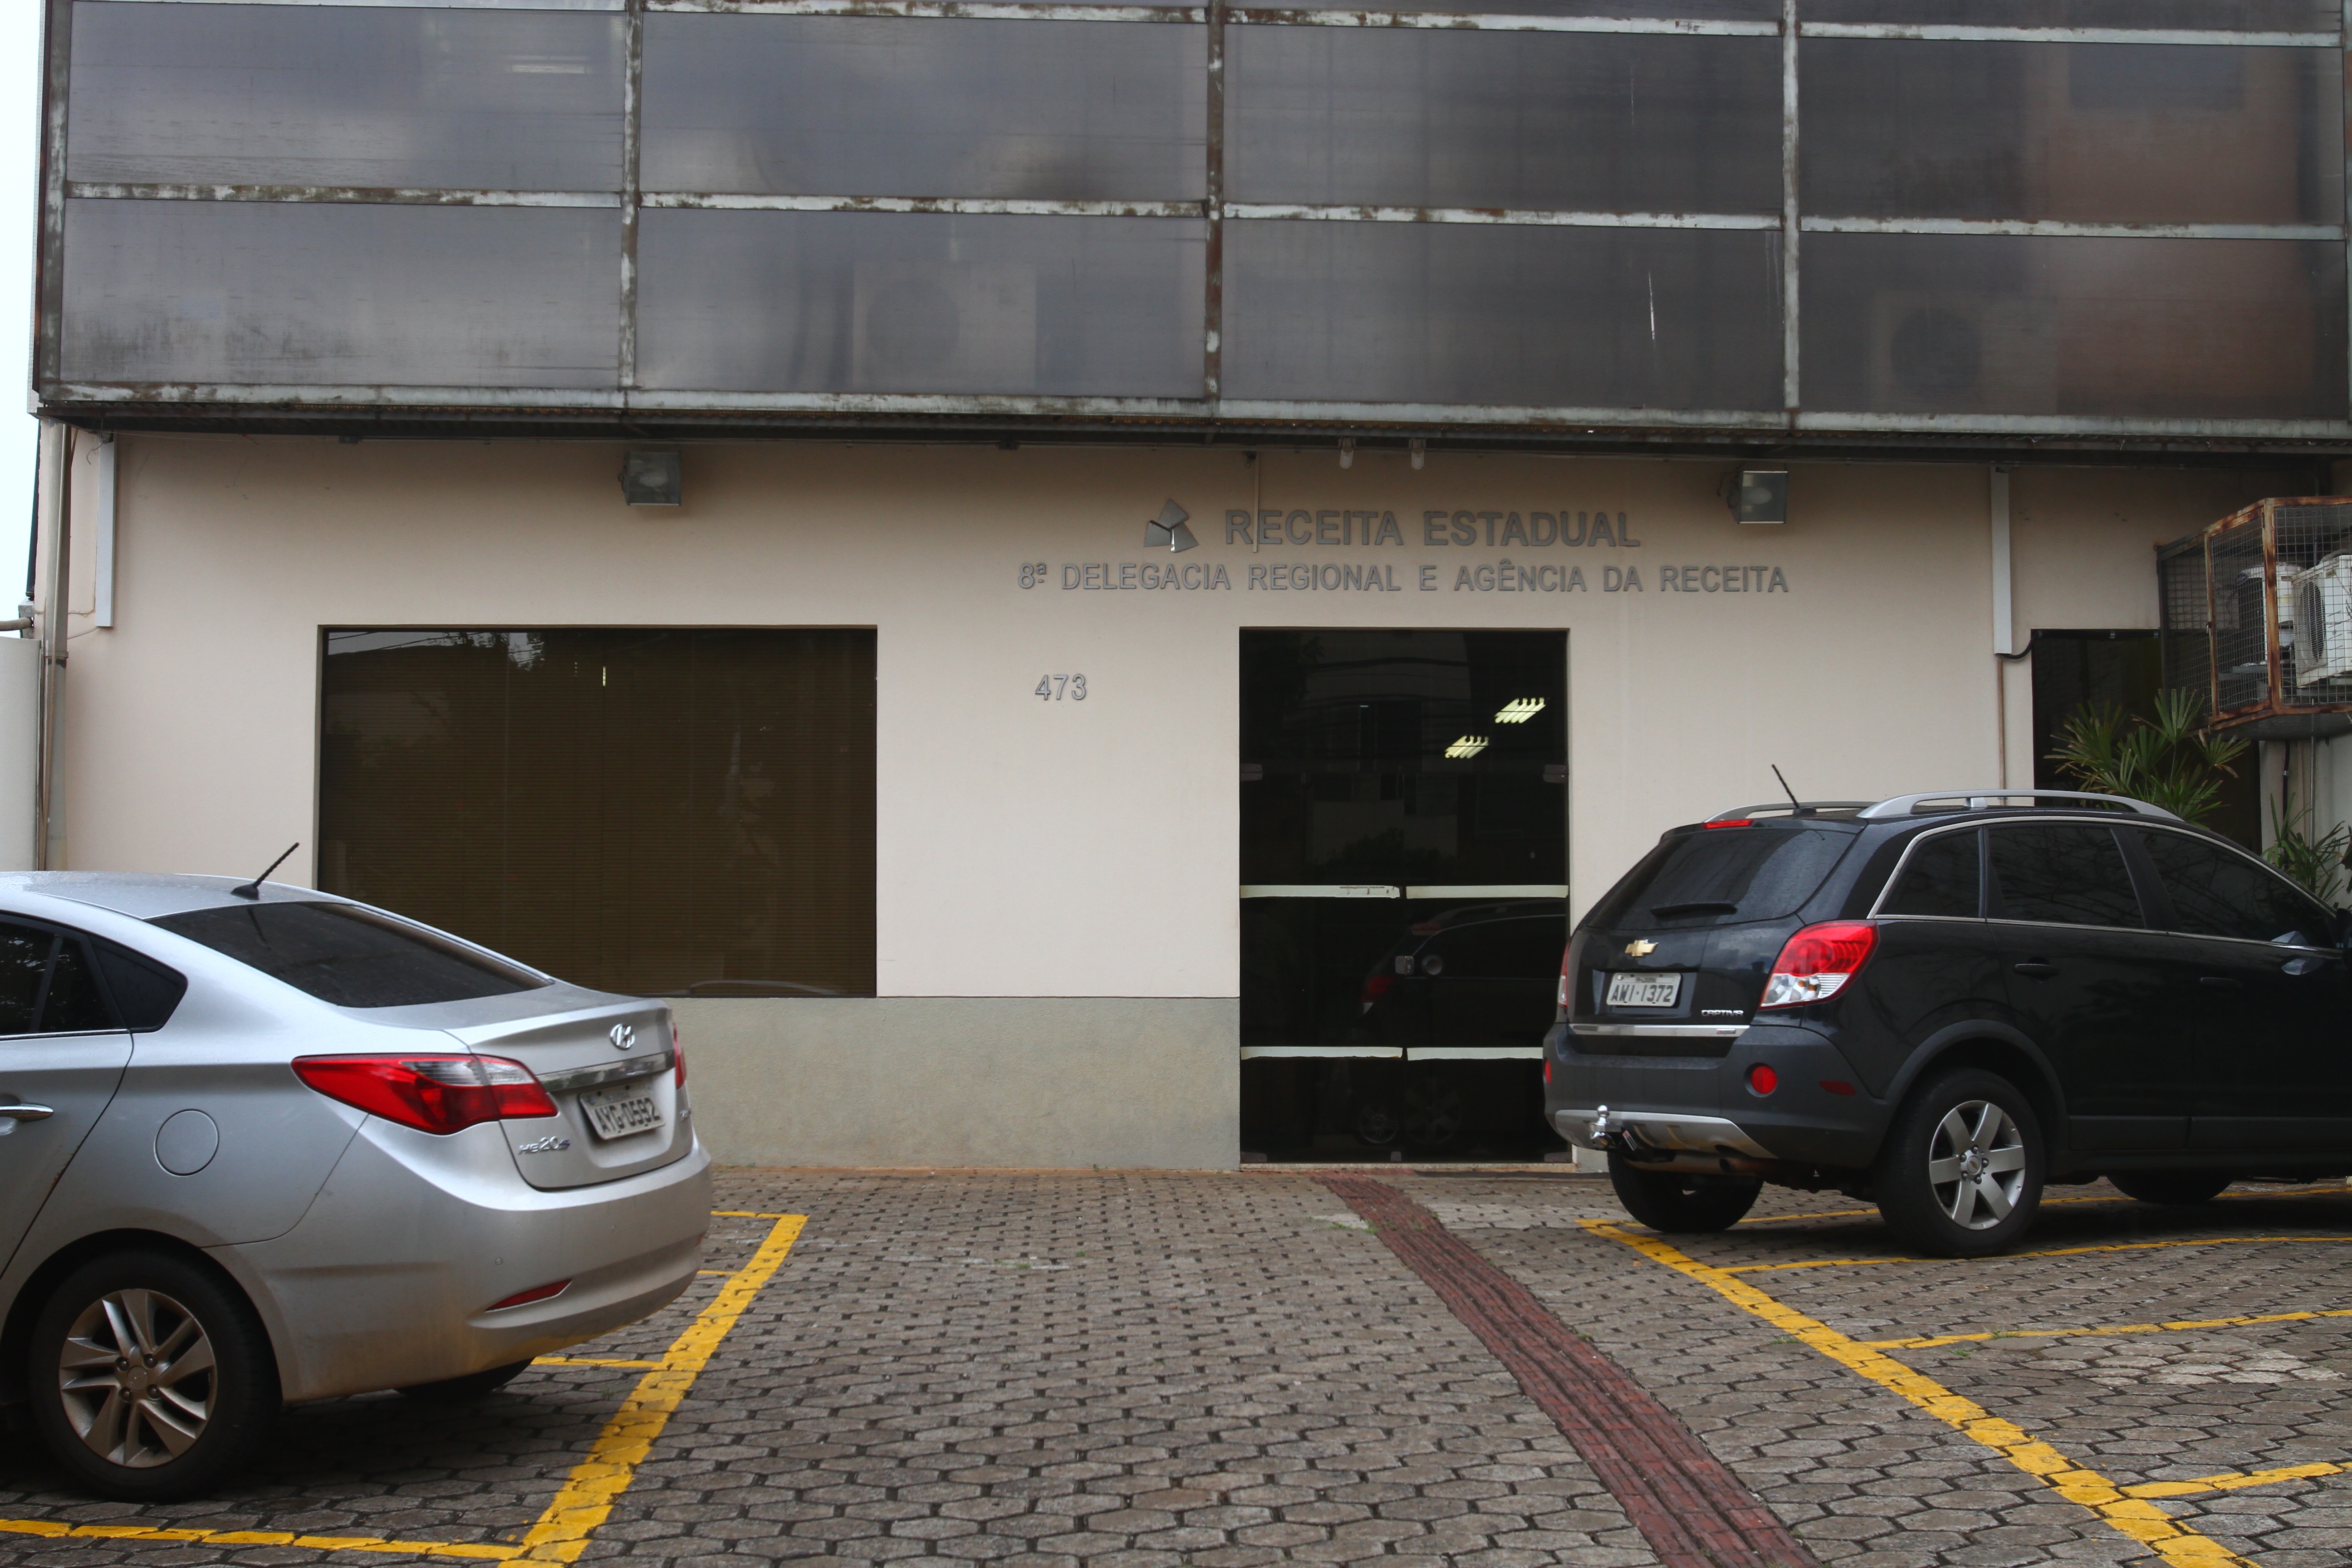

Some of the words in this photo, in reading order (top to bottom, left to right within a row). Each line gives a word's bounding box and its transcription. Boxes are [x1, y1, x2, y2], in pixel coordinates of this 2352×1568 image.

[1225, 510, 1404, 546] RECEITA
[1423, 510, 1641, 547] ESTADUAL
[1061, 563, 1231, 590] DELEGACIA
[1248, 564, 1402, 591] REGIONAL
[1419, 565, 1437, 591] E
[1454, 558, 1588, 592] AGÊNCIA
[1603, 565, 1644, 592] DA
[1660, 565, 1789, 593] RECEITA
[1035, 673, 1087, 700] 473
